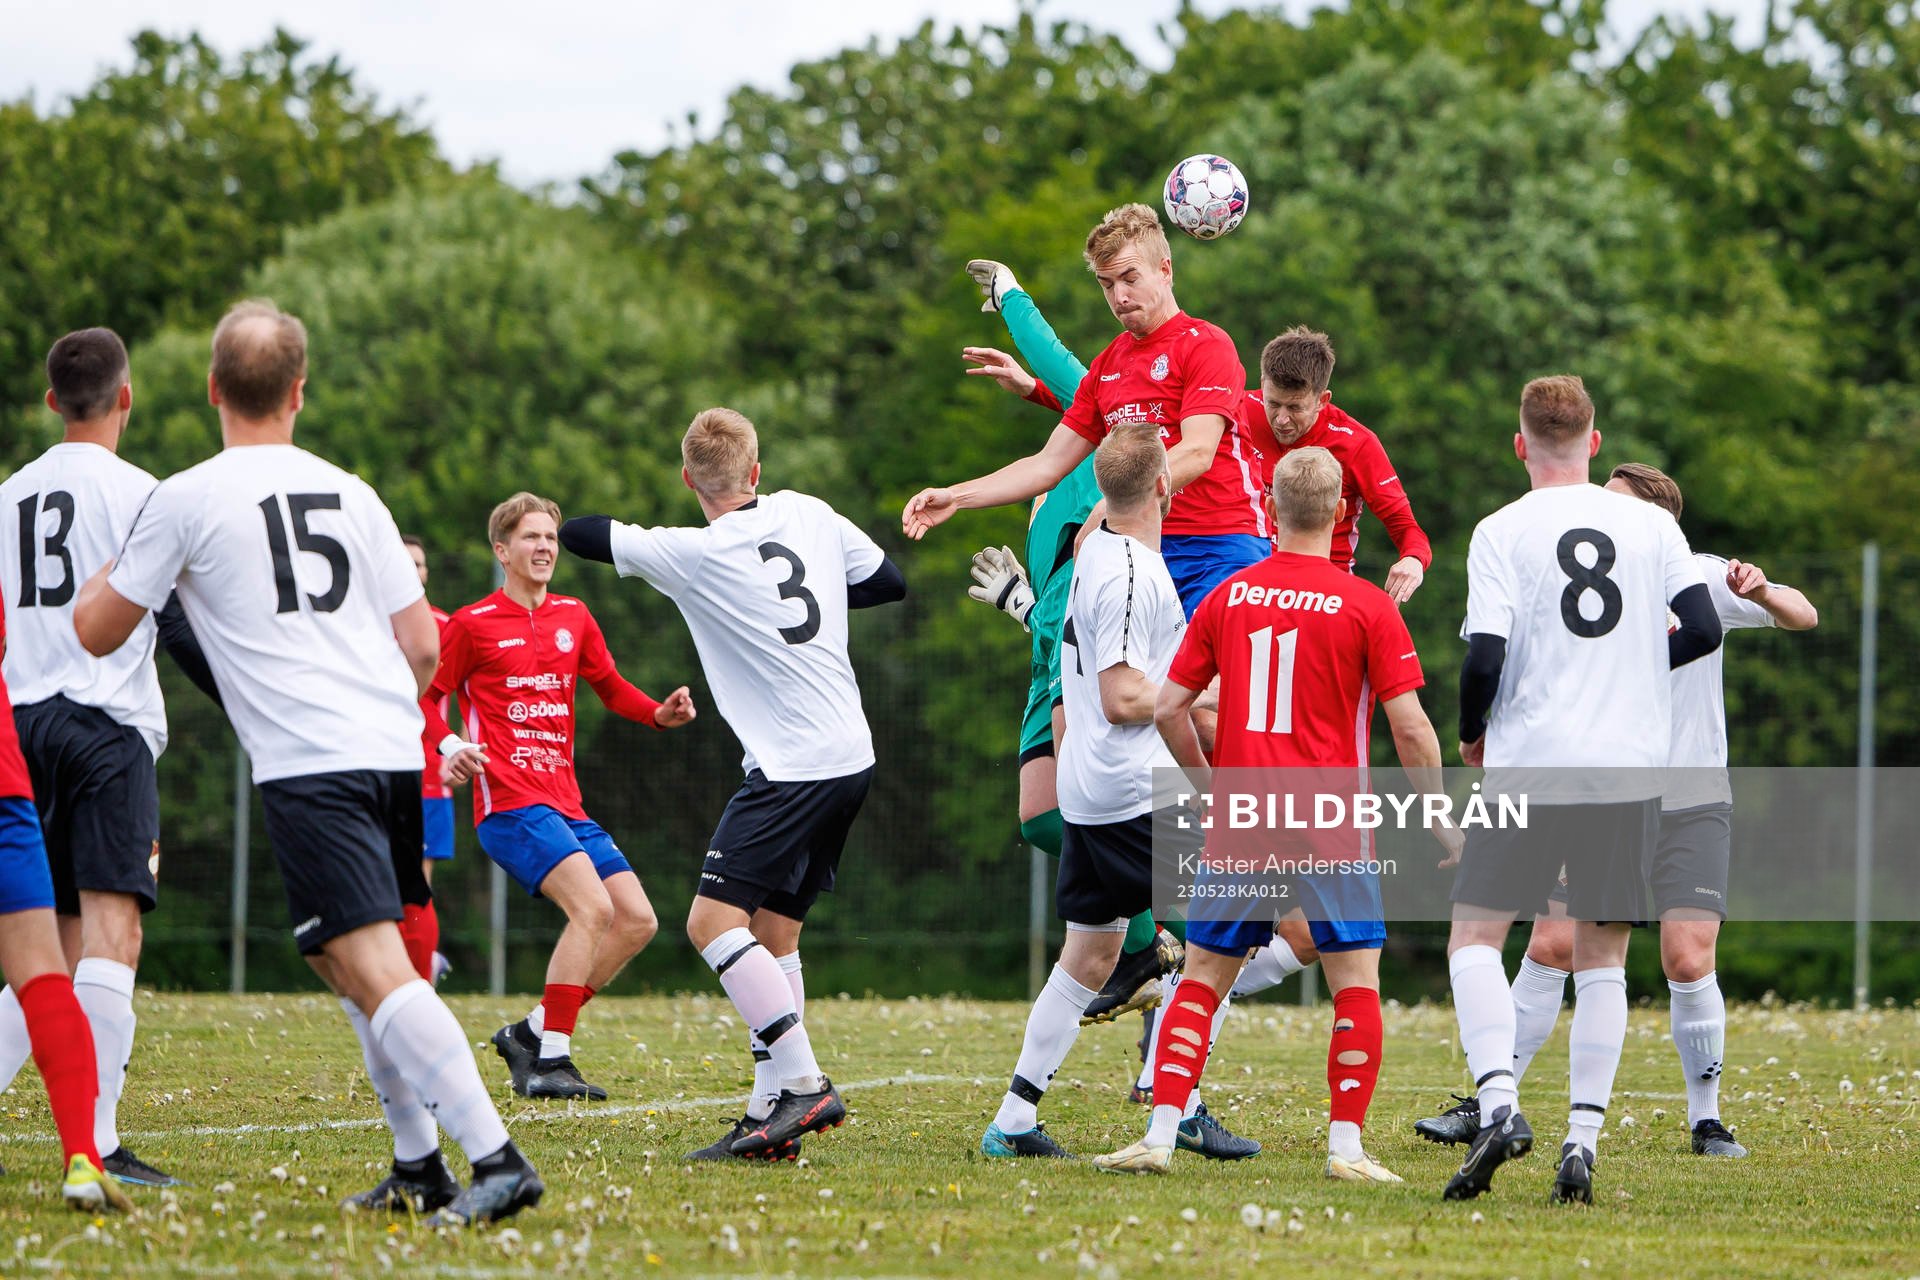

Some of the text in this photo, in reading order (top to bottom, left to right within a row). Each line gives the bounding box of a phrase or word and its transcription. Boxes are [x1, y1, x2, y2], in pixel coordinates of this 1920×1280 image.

[17, 490, 75, 608] 13
[258, 493, 350, 614] 15
[758, 541, 821, 645] 3
[1227, 581, 1343, 614] Derome
[1556, 527, 1623, 638] 8
[506, 673, 561, 689] SPINDEL
[1245, 625, 1298, 734] 11
